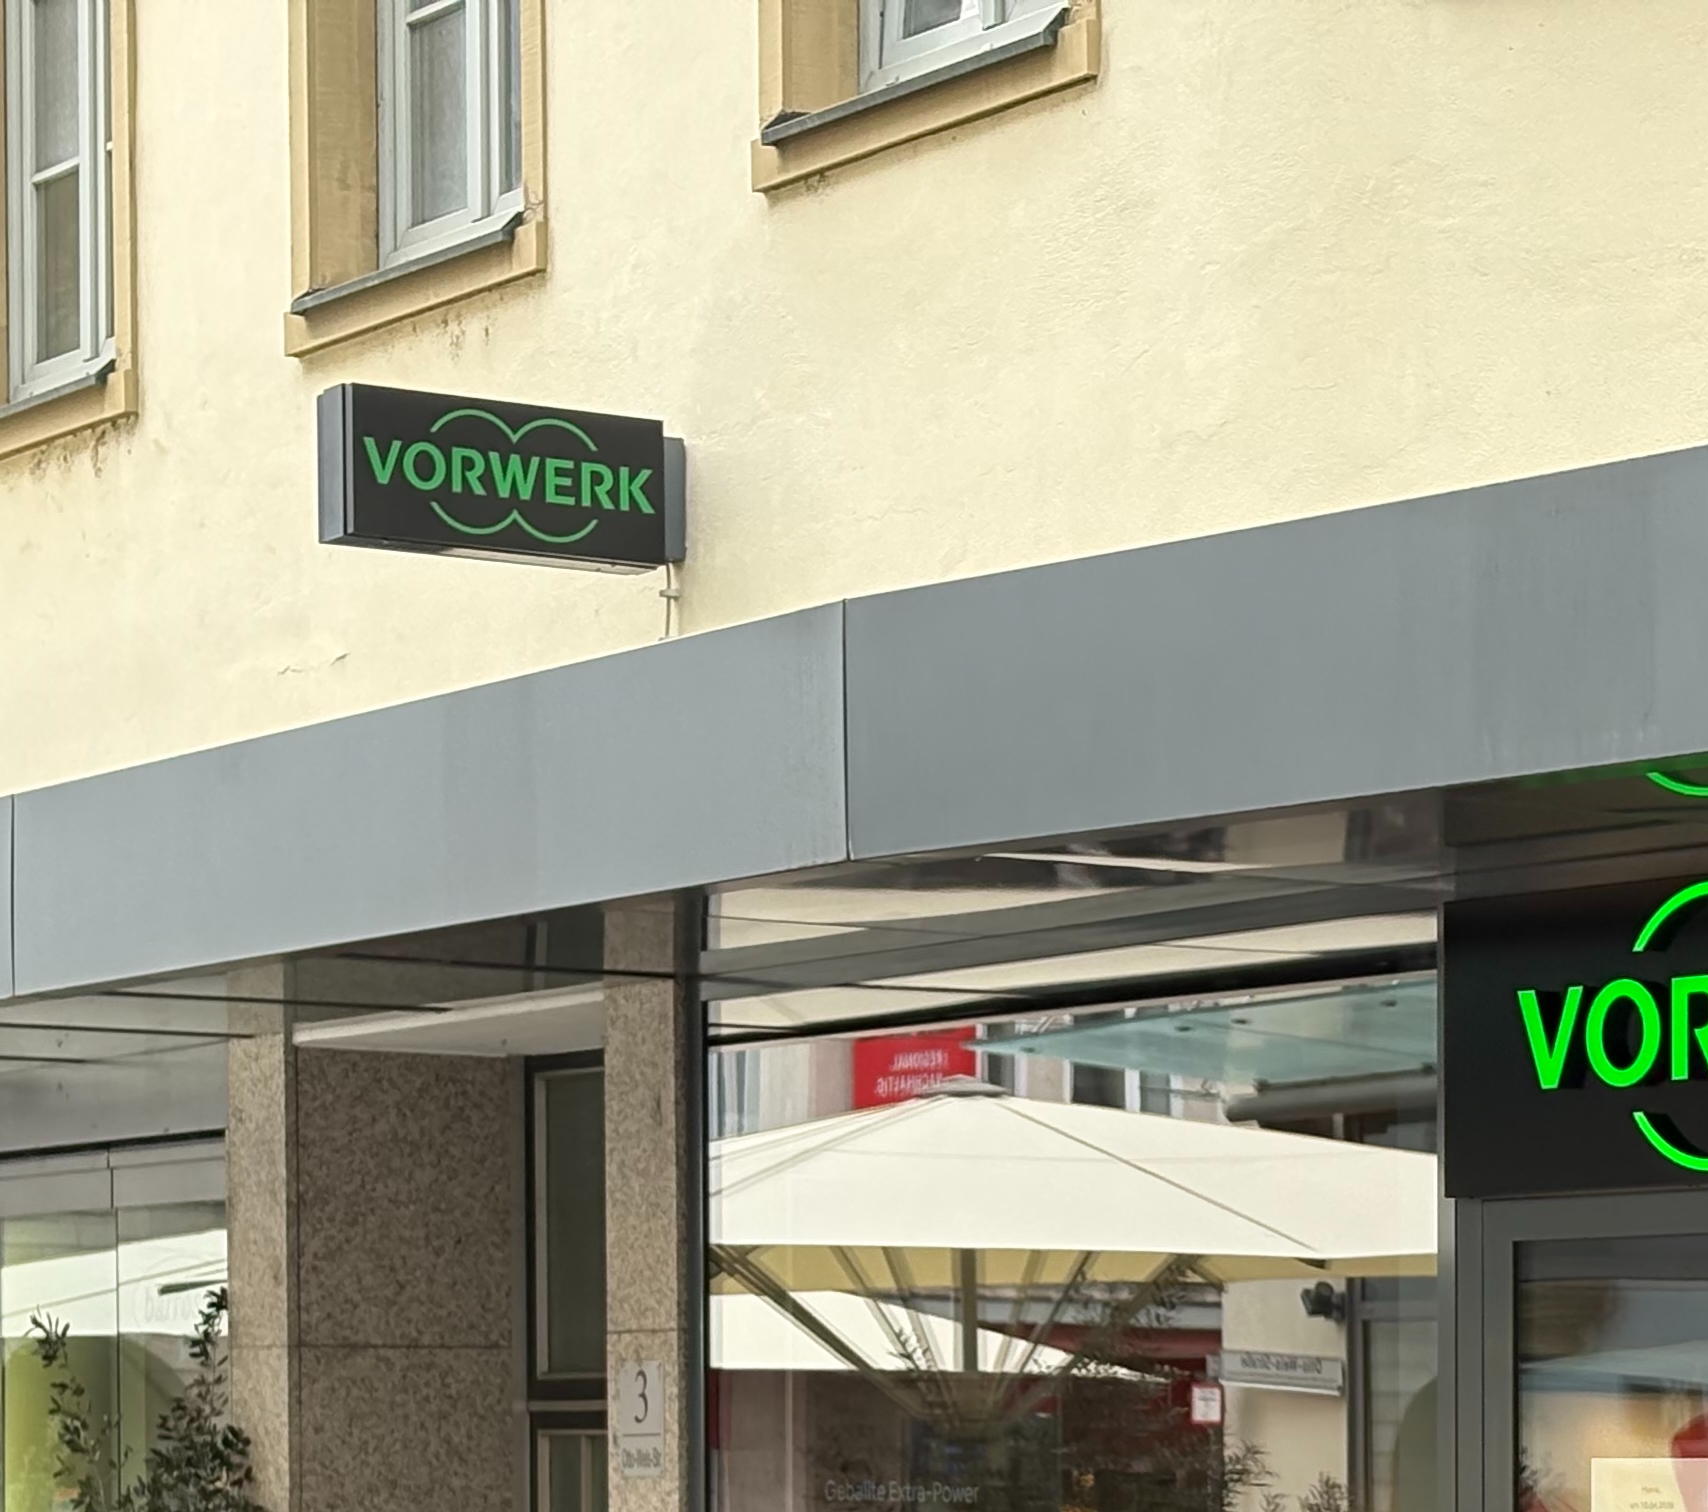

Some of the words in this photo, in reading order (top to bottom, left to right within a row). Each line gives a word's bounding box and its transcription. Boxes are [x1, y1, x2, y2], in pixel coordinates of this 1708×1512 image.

[363, 436, 656, 514] VORWERK
[634, 1369, 648, 1424] 3
[825, 1480, 886, 1501] Geballte
[888, 1481, 979, 1503] Extra-Power
